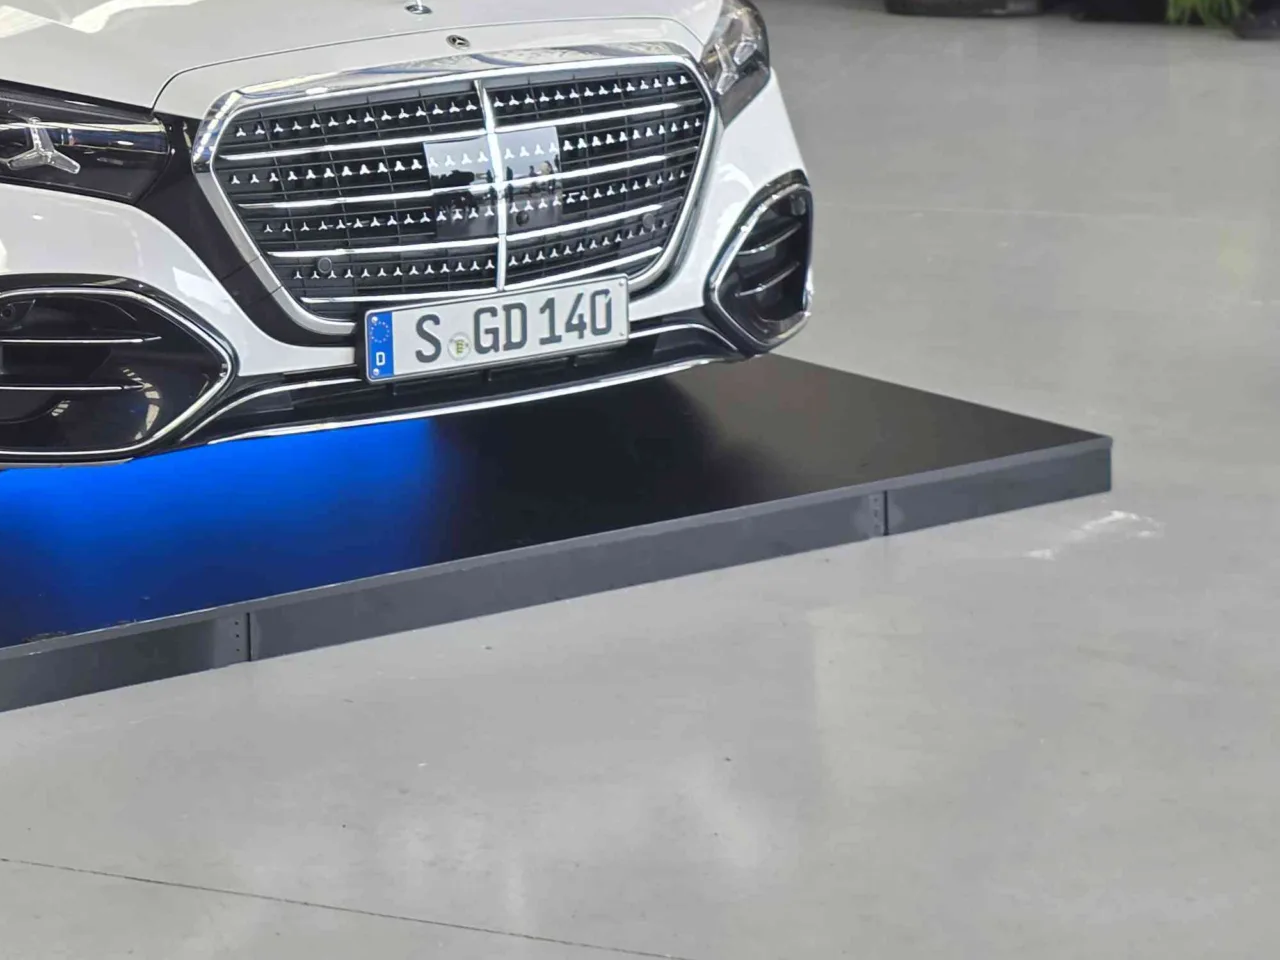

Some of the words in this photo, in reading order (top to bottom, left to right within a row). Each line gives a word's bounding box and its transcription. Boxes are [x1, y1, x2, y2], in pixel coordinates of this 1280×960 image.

[415, 313, 442, 363] S
[473, 302, 528, 355] GD
[538, 289, 612, 346] 140
[375, 351, 386, 366] D
